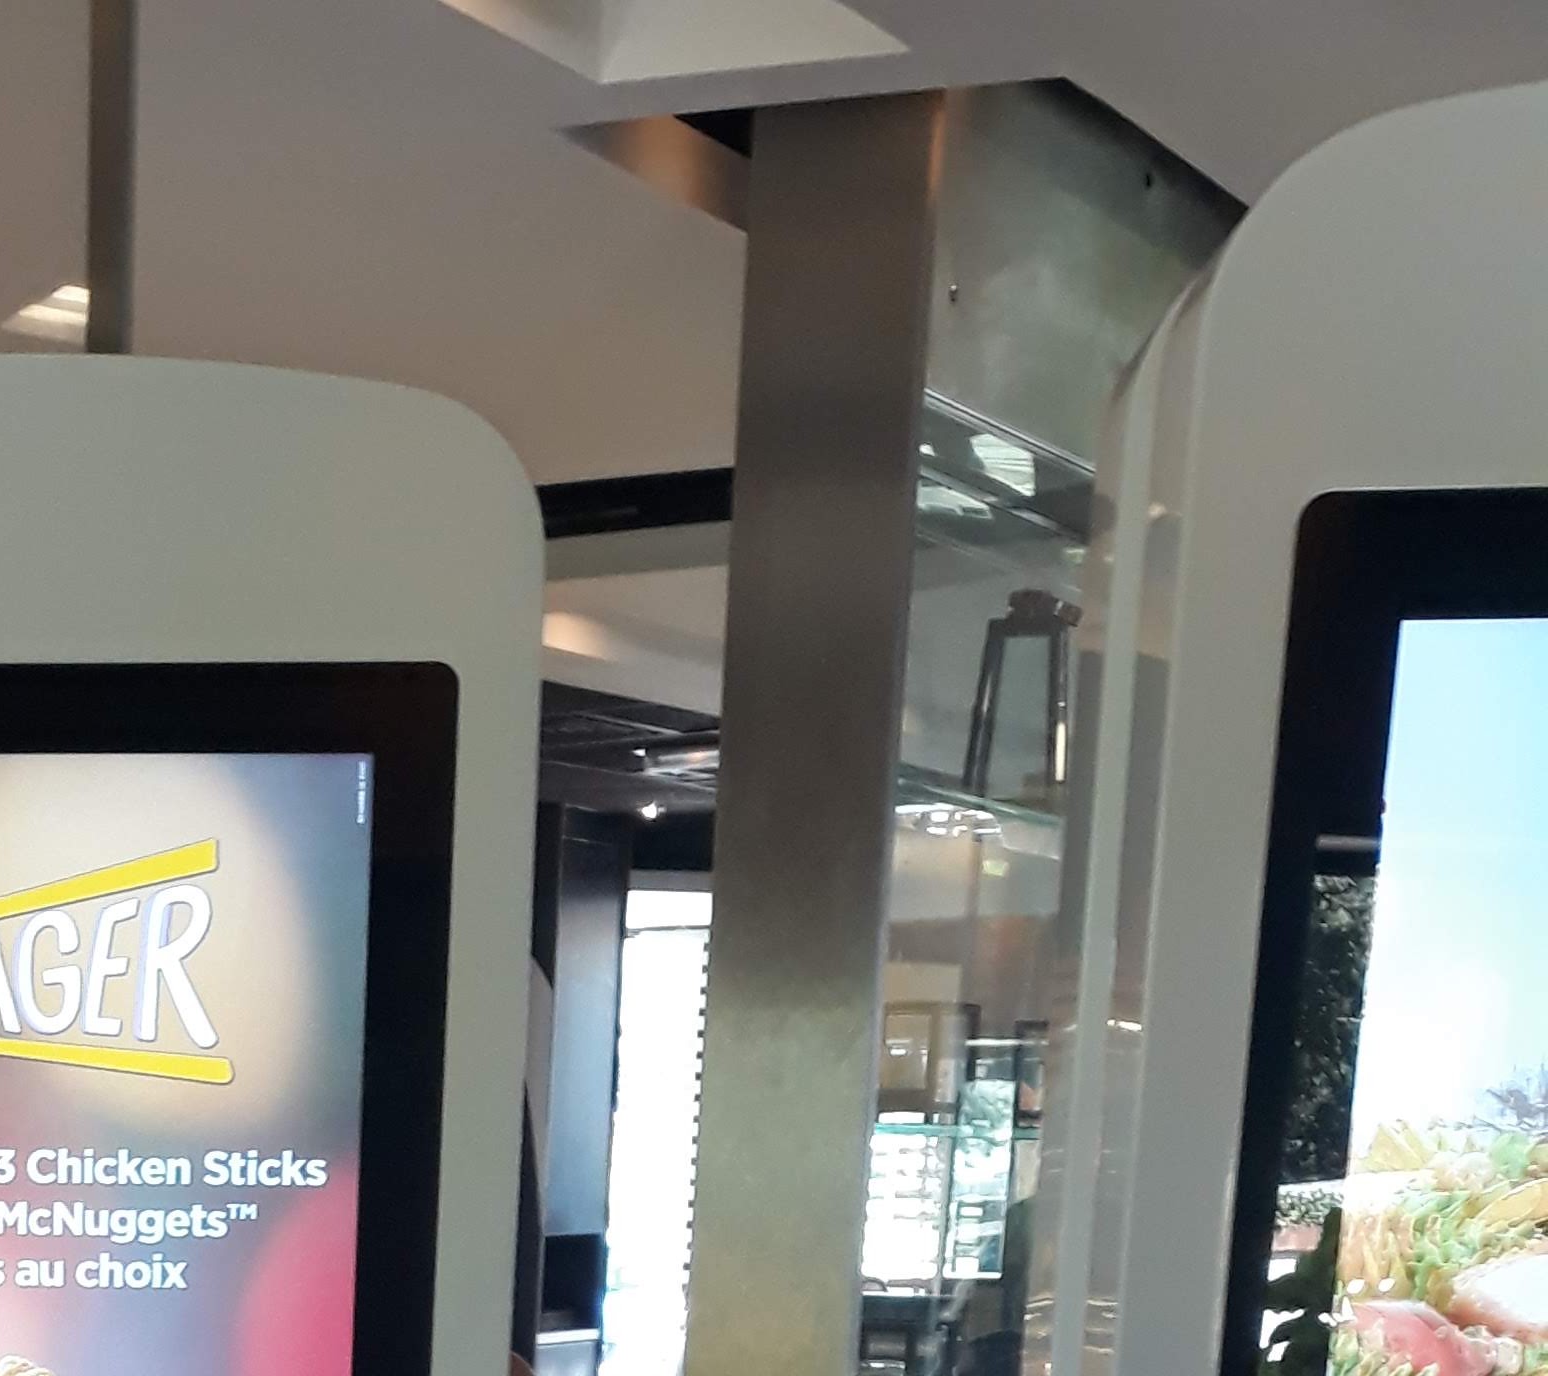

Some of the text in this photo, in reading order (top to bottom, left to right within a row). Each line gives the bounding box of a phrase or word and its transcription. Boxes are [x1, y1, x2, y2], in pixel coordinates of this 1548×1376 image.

[26, 1148, 191, 1186] Chicken
[203, 1150, 327, 1187] Sticks
[15, 1260, 65, 1288] au
[75, 1253, 188, 1289] choix
